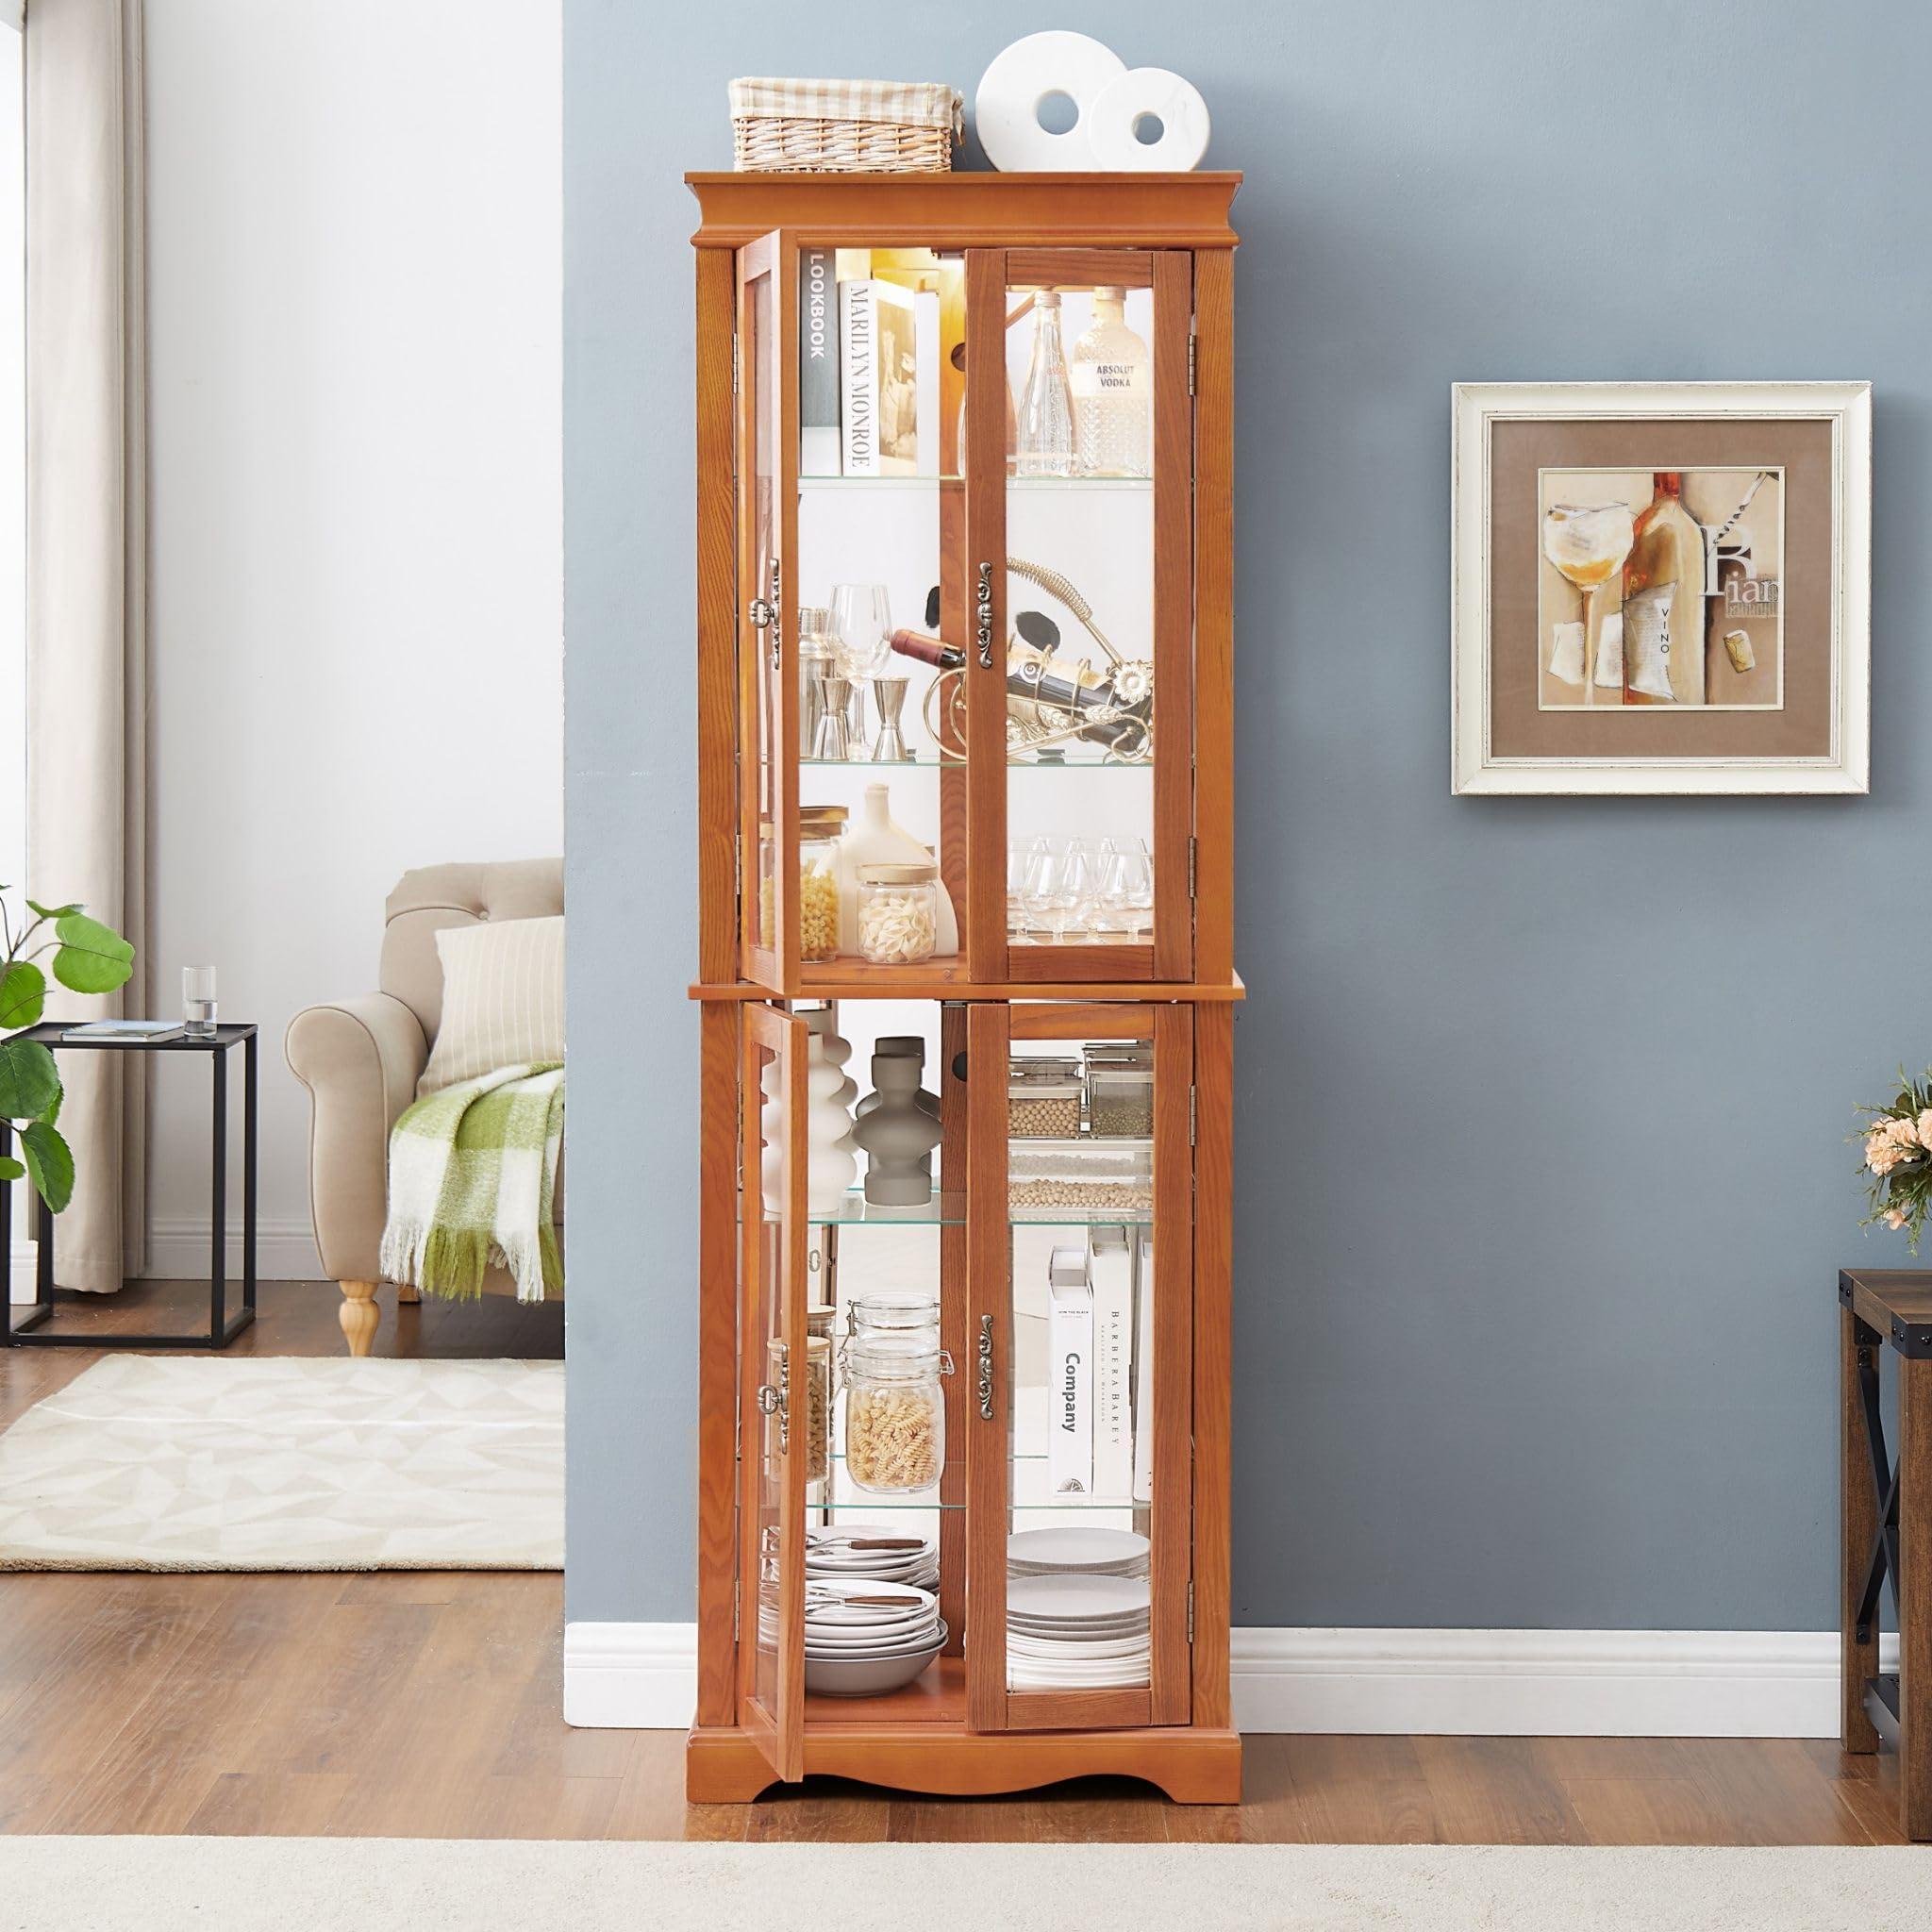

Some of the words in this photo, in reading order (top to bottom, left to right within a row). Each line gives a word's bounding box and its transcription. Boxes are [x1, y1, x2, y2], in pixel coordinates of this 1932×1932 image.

[809, 254, 825, 358] LOOKBOOK
[850, 288, 870, 377] MARILYN
[1097, 365, 1134, 375] ABSOLUT
[1100, 378, 1131, 387] VODKA
[851, 384, 871, 468] MONROE
[1660, 608, 1670, 654] VINO
[1061, 1353, 1080, 1433] Company
